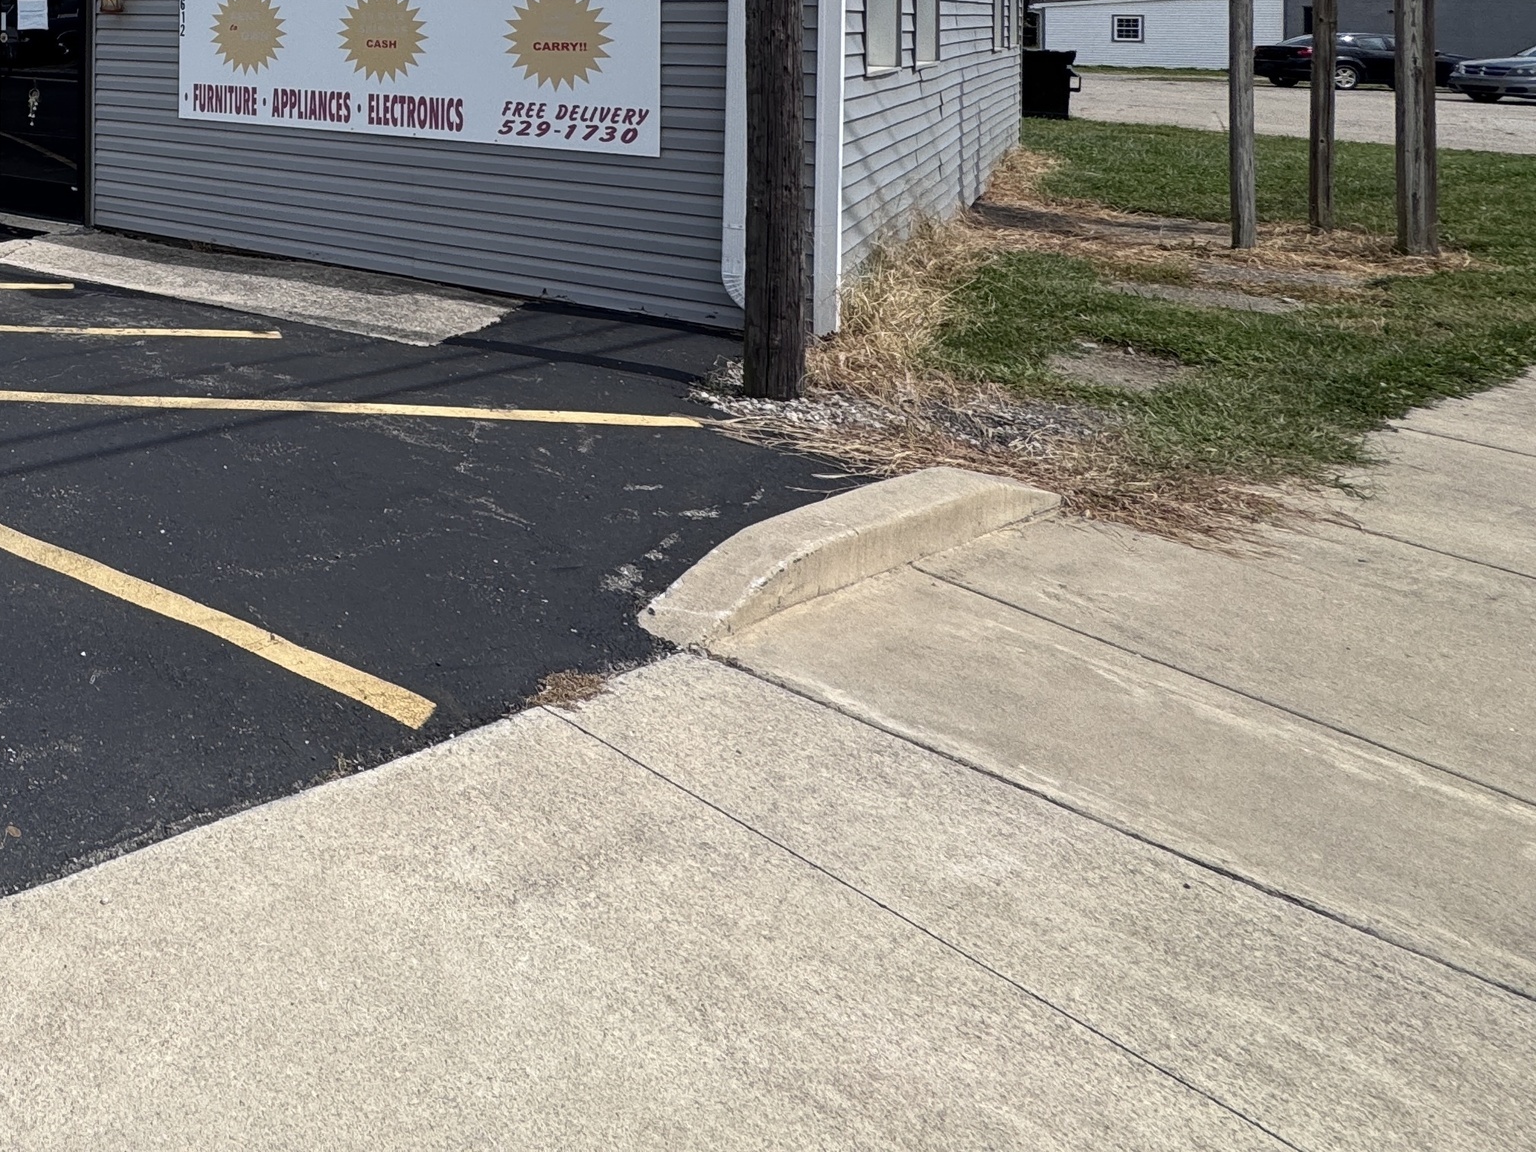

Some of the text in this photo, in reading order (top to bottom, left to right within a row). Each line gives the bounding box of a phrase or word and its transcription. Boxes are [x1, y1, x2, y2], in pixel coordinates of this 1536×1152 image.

[366, 39, 397, 49] CASH
[533, 42, 587, 52] CARRY!!
[193, 83, 464, 132] FURNITURE APPLIANCES ELECTRONICS
[501, 100, 649, 126] FREE DELIVERY
[497, 119, 639, 144] 529-1730
